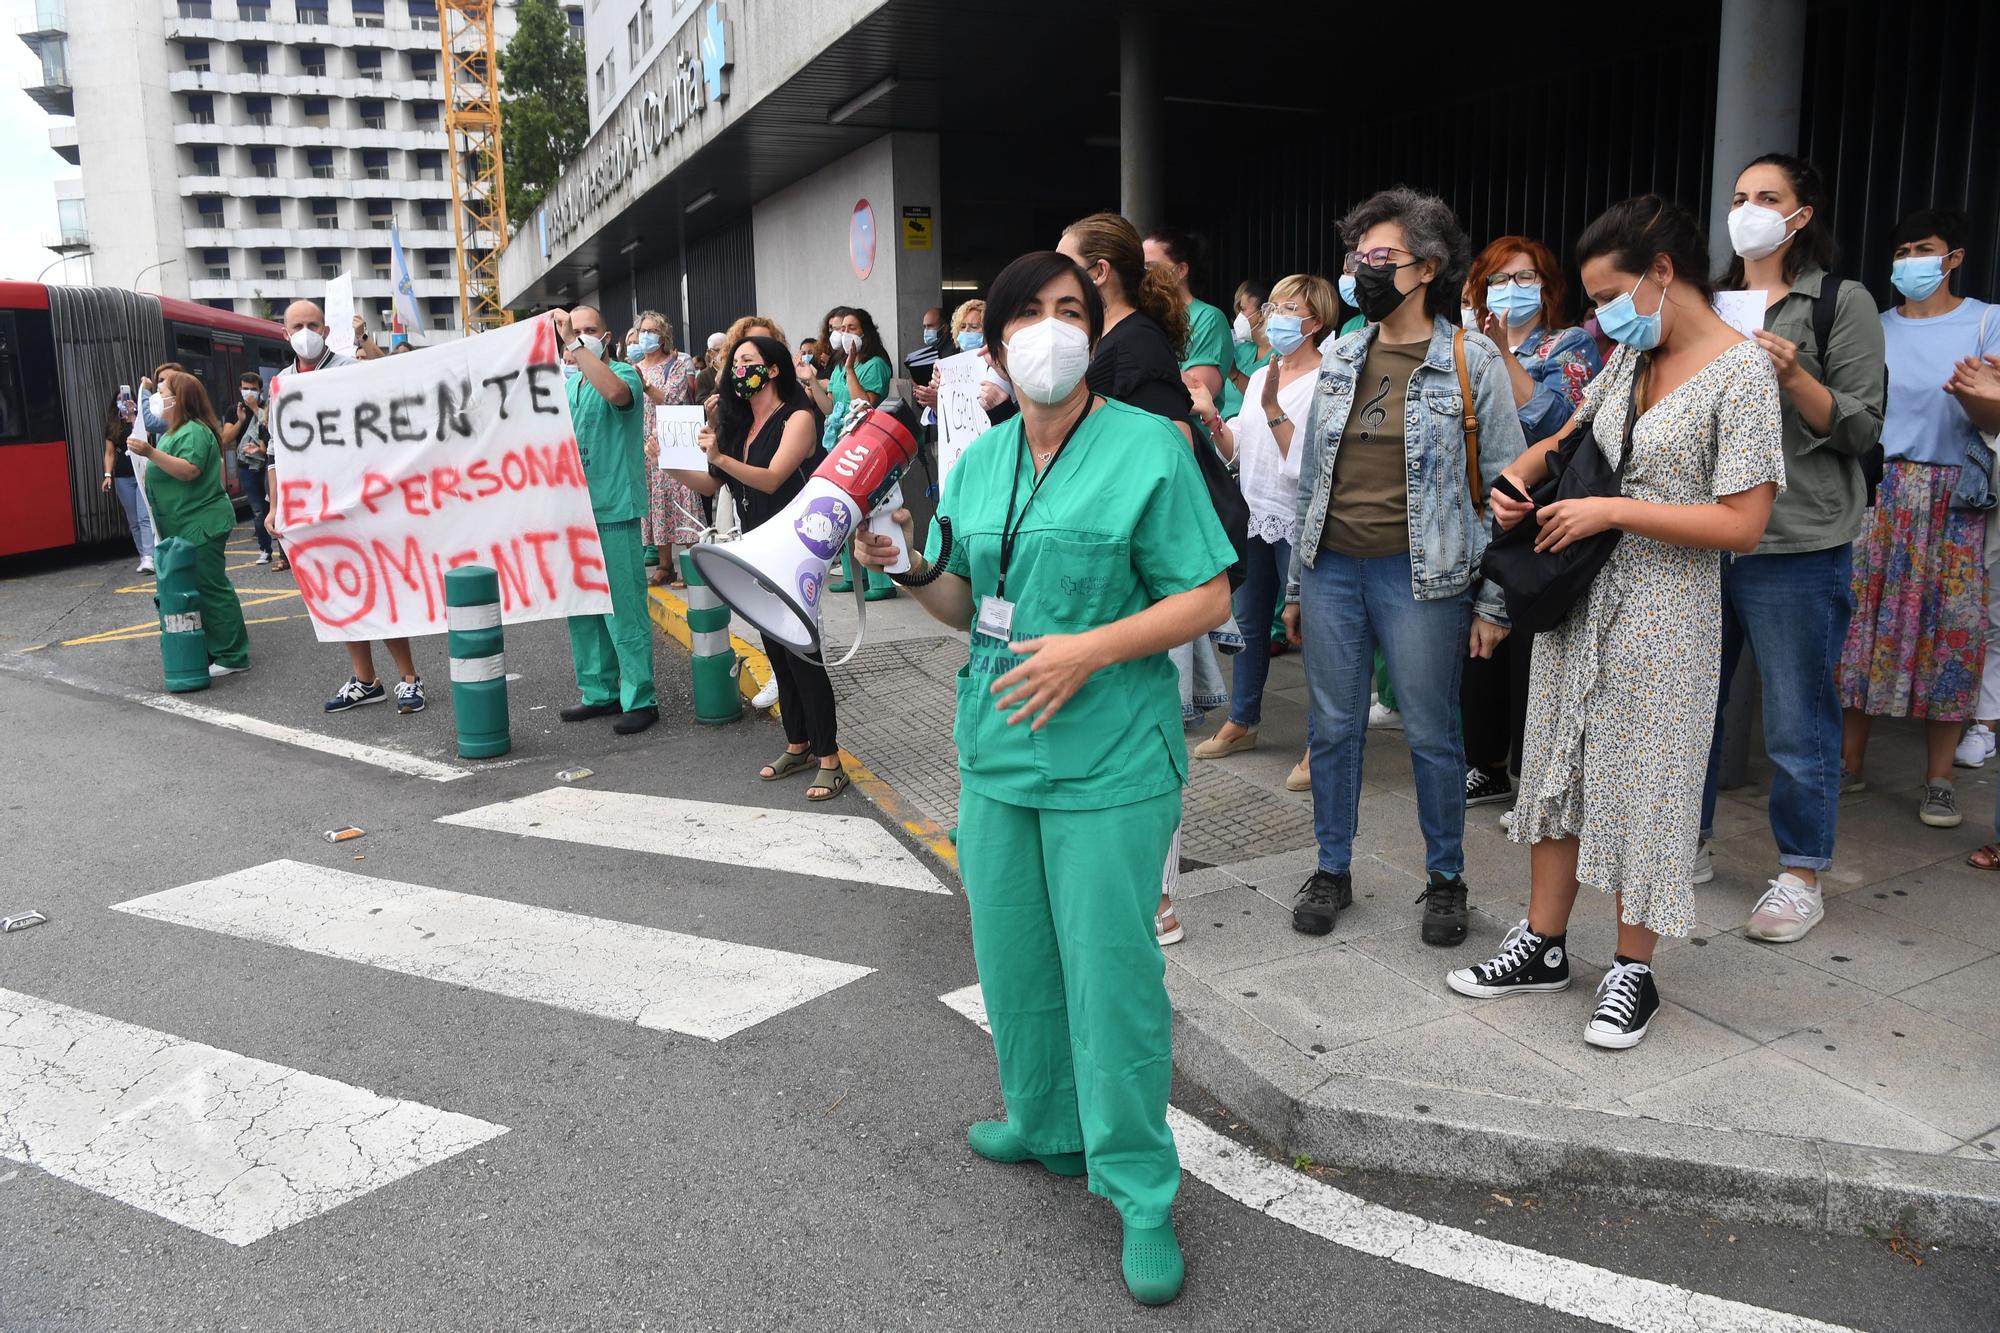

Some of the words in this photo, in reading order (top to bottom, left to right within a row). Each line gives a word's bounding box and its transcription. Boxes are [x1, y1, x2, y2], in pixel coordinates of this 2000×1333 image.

[643, 51, 706, 153] Coruña
[276, 363, 560, 452] GERENTE
[281, 479, 346, 527] EL
[372, 526, 610, 624] MINTE
